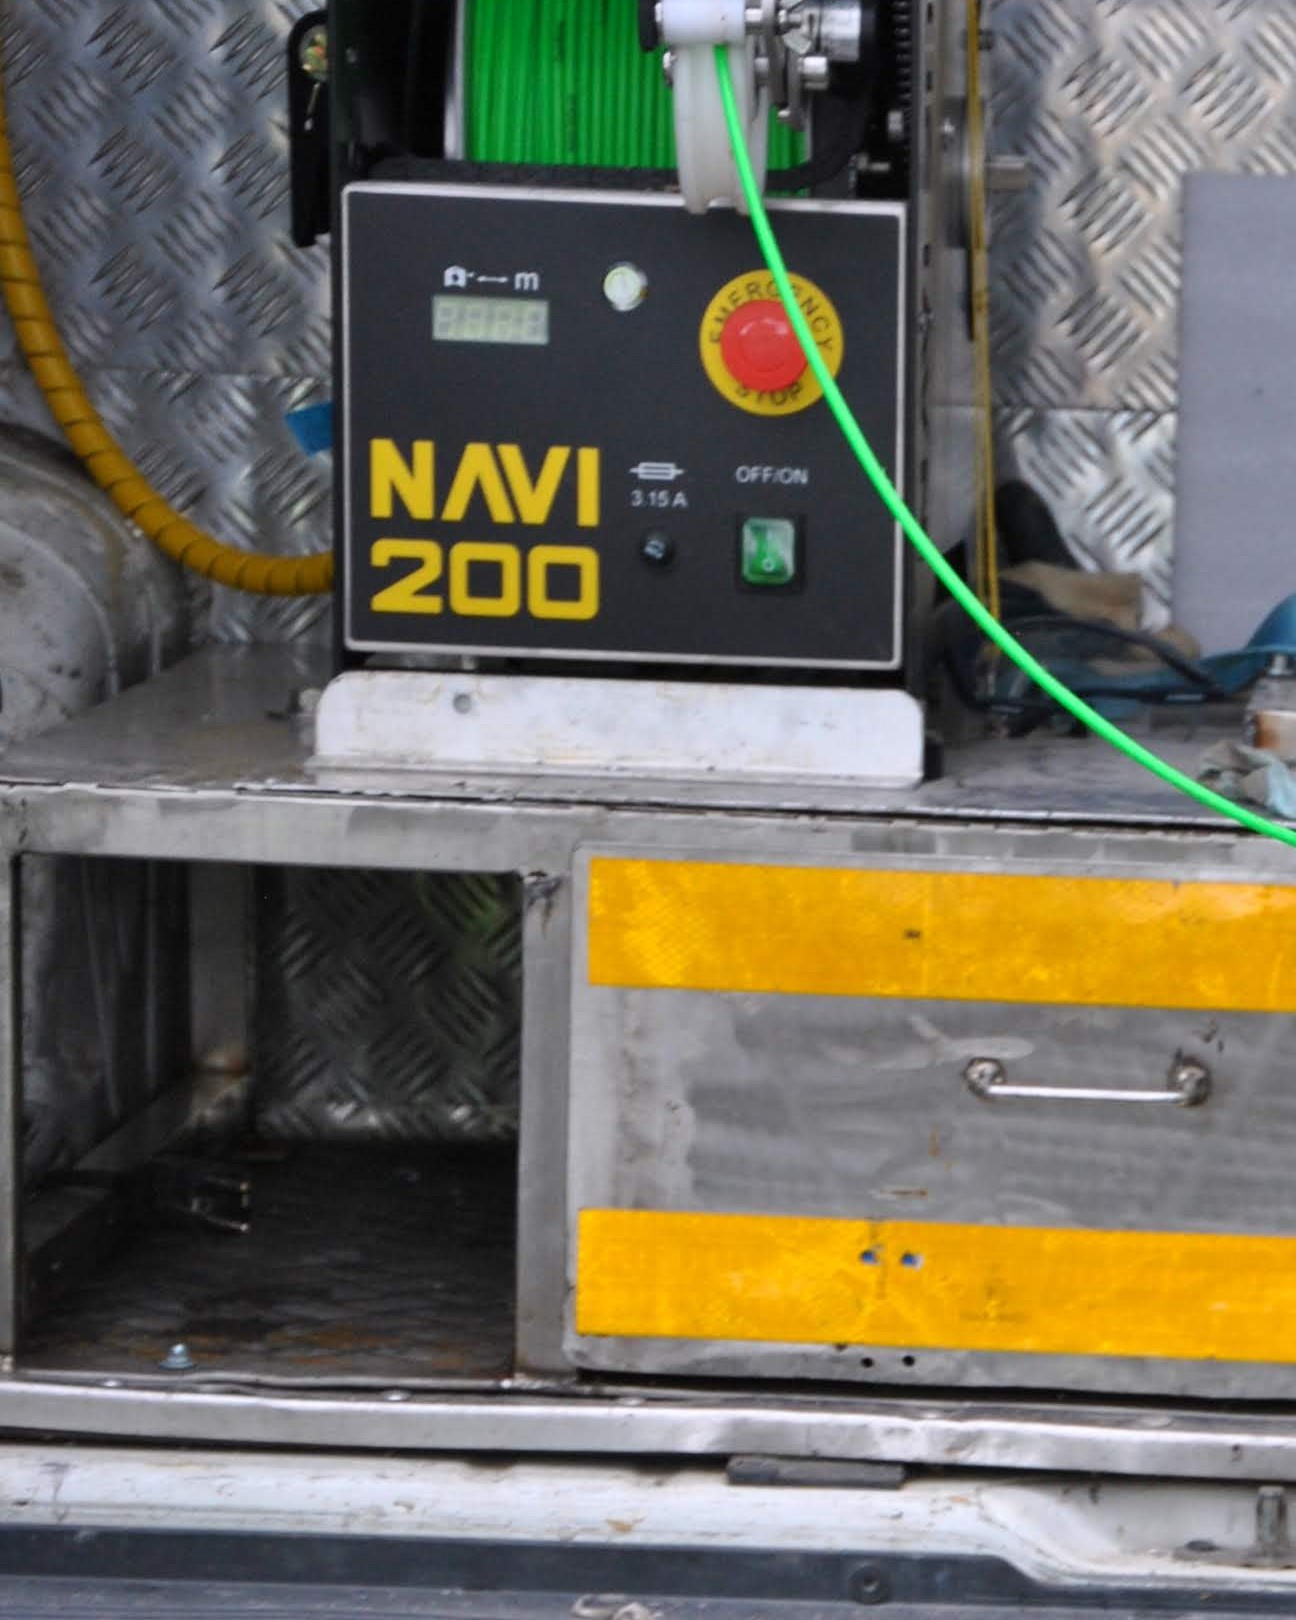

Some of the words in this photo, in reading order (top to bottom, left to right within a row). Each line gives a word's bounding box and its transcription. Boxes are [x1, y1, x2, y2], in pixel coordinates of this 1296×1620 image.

[514, 271, 540, 291] m
[735, 381, 804, 406] STOP
[370, 438, 600, 527] NAVI
[735, 464, 809, 485] OFF/ON
[631, 489, 669, 508] 3.15
[672, 490, 688, 508] A
[370, 538, 600, 620] 200
